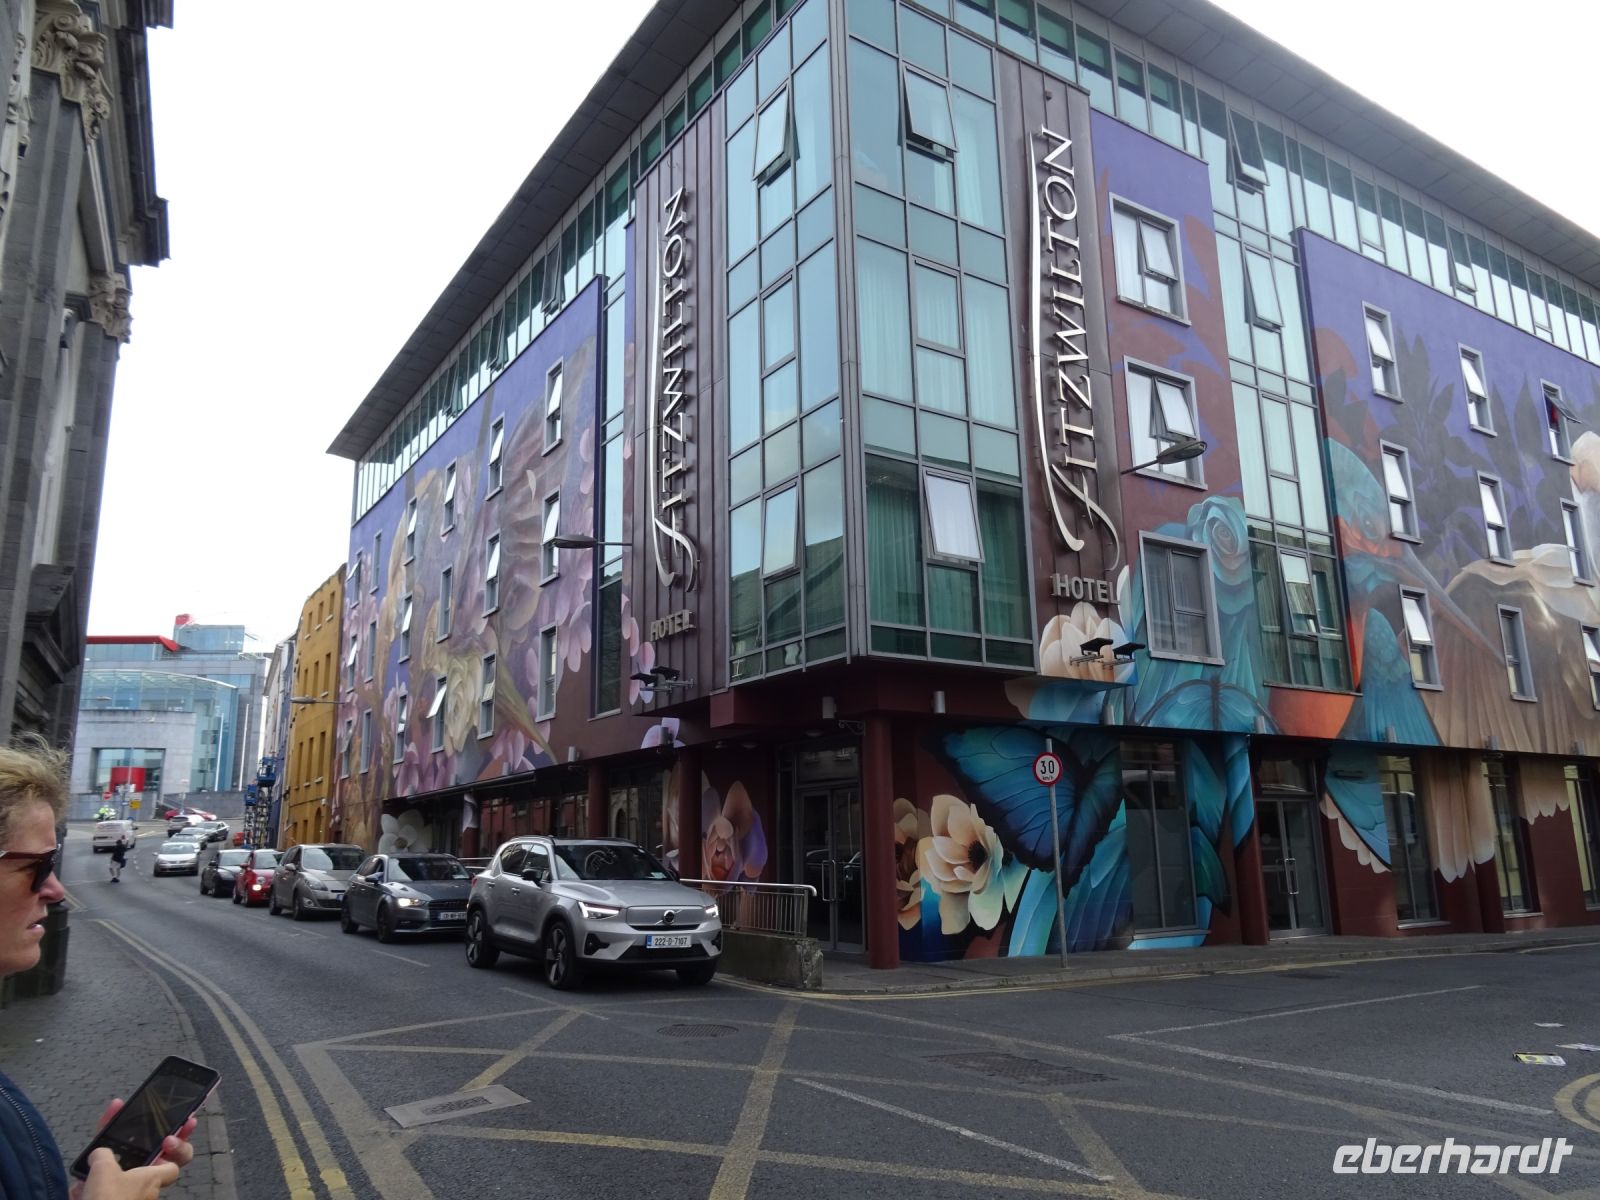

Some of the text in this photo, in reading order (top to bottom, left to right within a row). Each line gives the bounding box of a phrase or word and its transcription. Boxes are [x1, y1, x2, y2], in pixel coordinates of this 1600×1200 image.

[1053, 573, 1120, 605] HOTEL
[650, 609, 691, 642] HOTEL
[1040, 760, 1055, 775] 30
